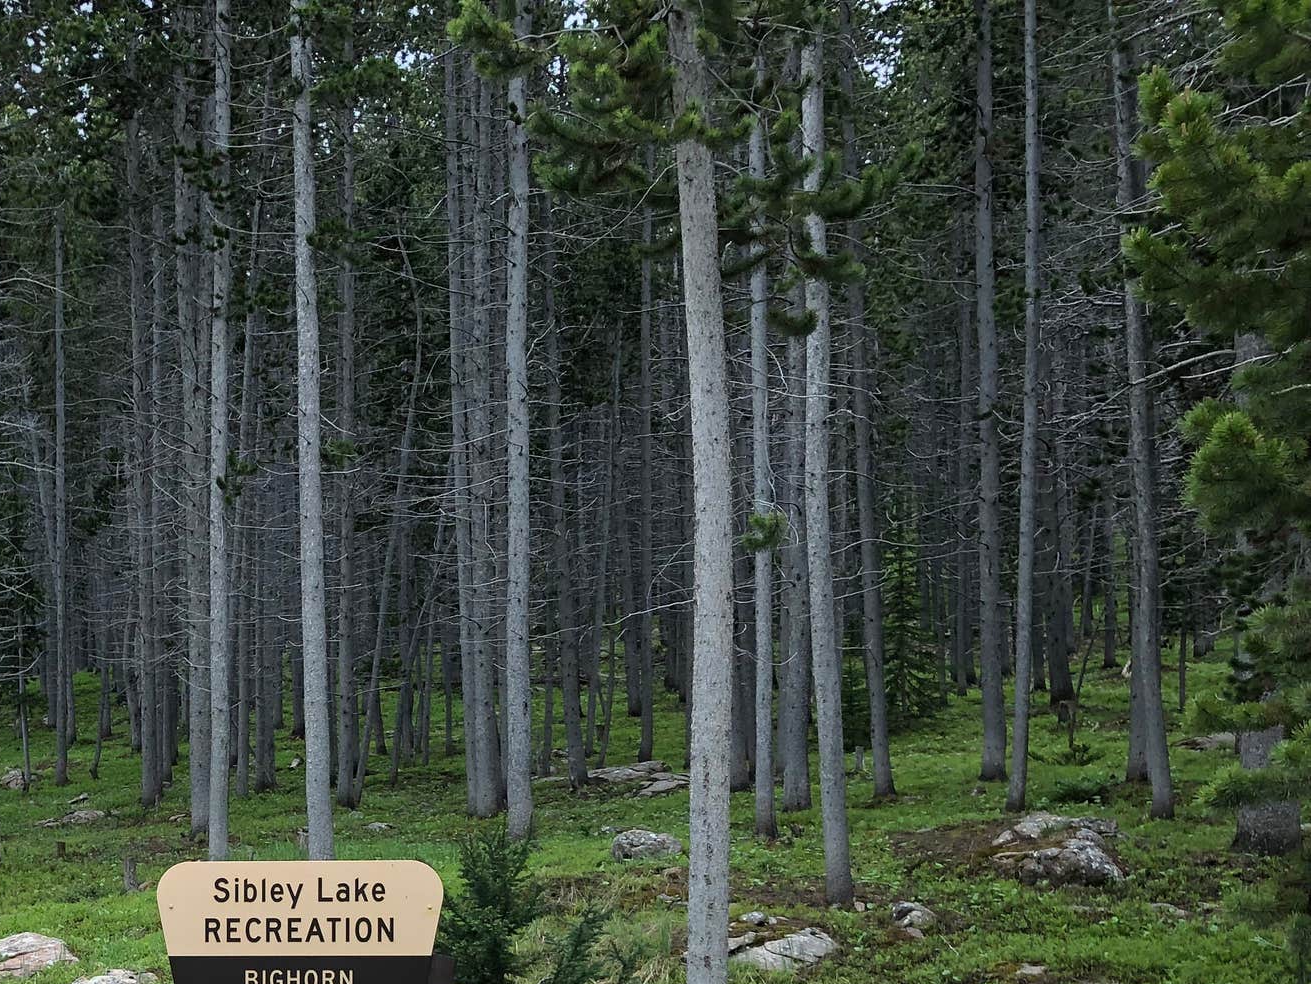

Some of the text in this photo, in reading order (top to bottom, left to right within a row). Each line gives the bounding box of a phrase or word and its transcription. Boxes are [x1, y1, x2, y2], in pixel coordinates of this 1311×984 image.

[214, 877, 386, 909] Sibley Lake
[204, 917, 395, 943] RECREATION
